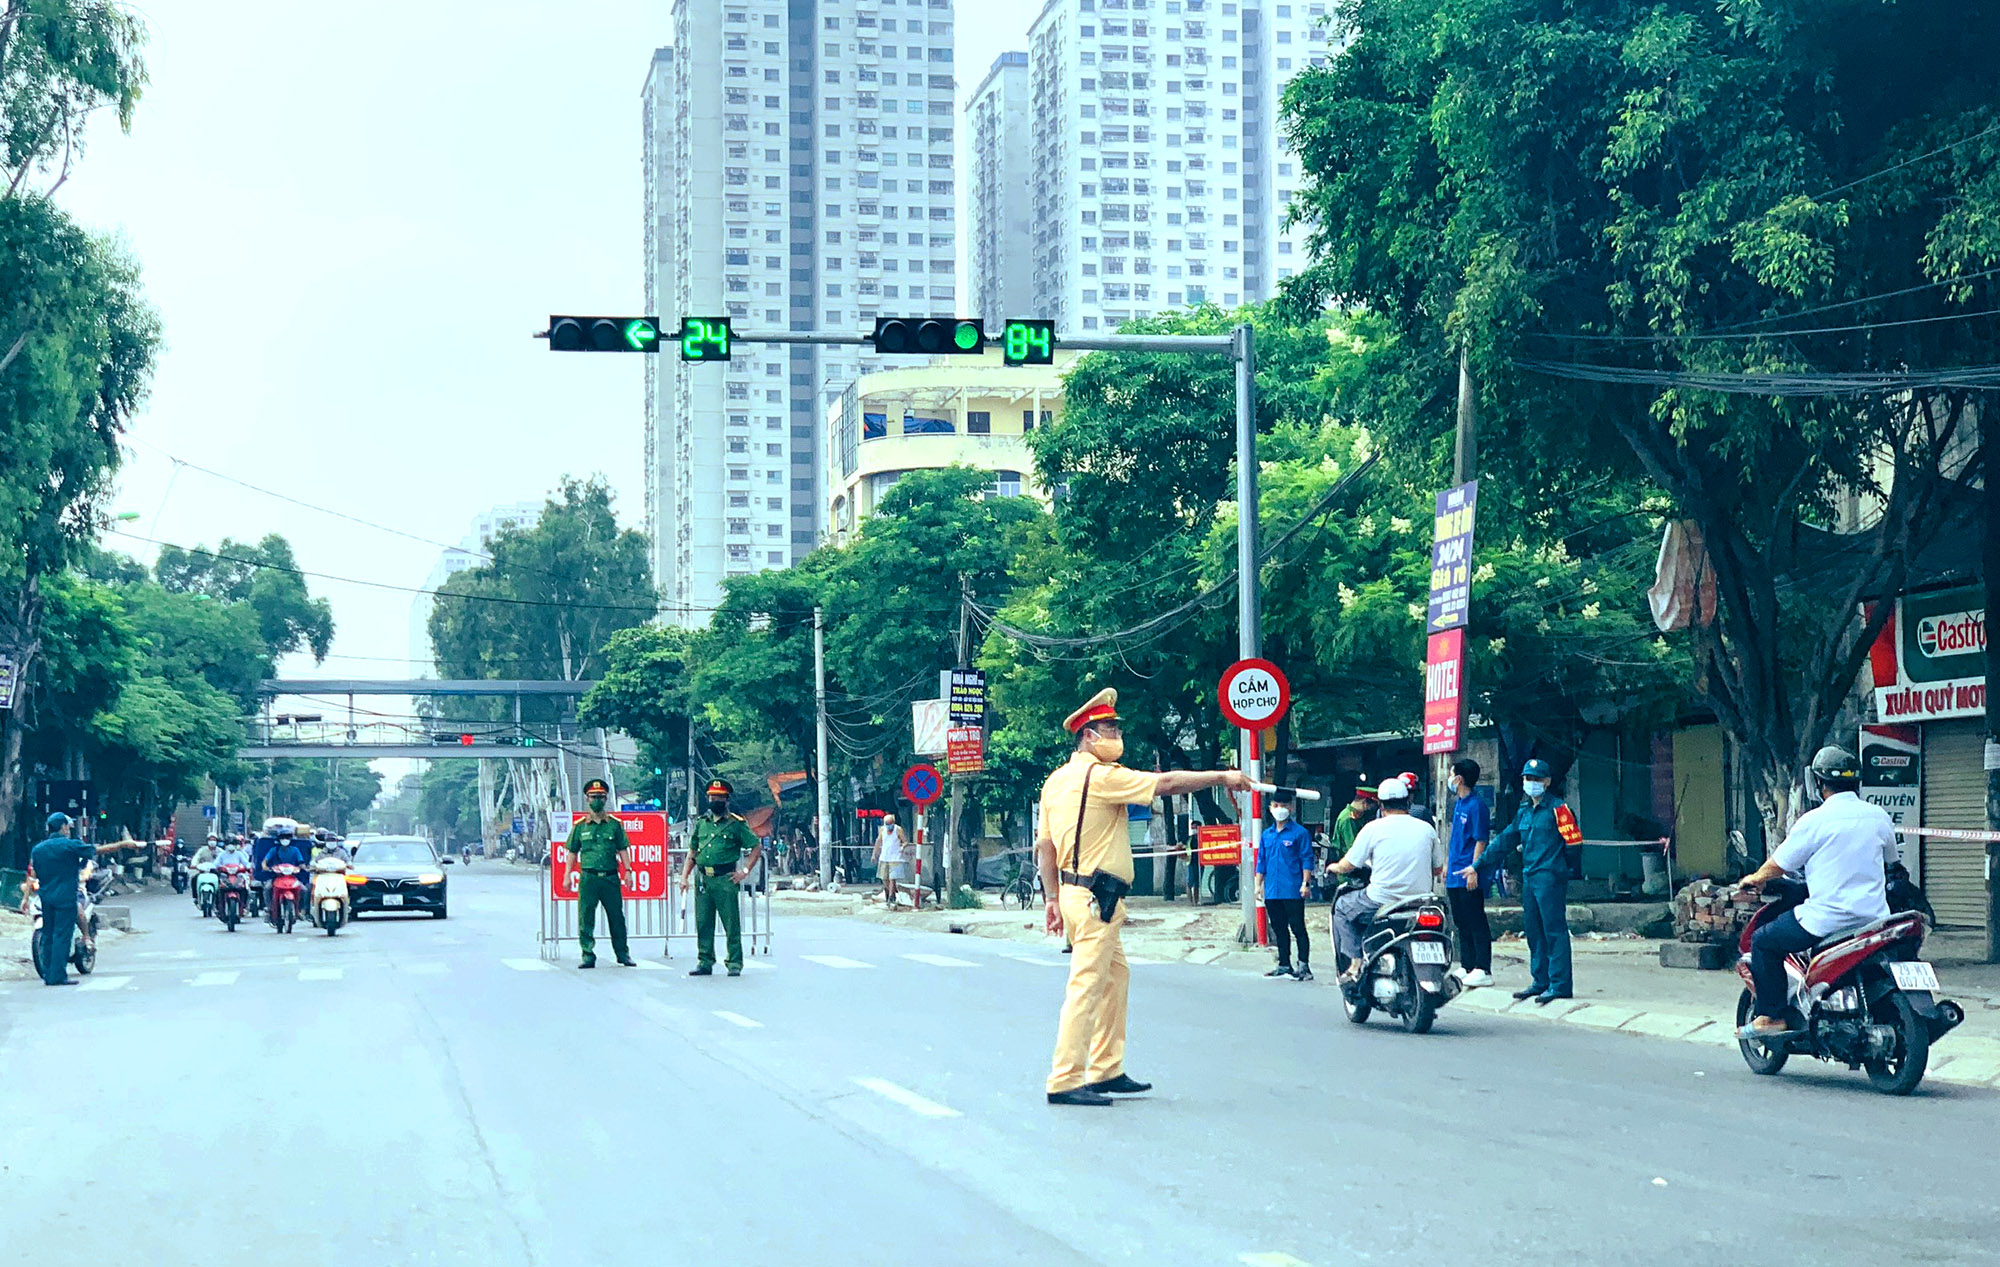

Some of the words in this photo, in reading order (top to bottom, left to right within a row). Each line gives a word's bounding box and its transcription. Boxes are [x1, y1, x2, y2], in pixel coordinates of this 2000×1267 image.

[683, 320, 727, 357] 24
[1007, 323, 1049, 360] 84
[1238, 675, 1269, 694] CẤM
[1426, 659, 1458, 702] HOTEL
[1233, 698, 1255, 710] HỌP
[1256, 695, 1277, 708] CHỢ
[1885, 687, 1922, 716] XUÂN
[1925, 682, 1955, 715] QUÝ
[1866, 793, 1915, 806] CHUYÊN
[639, 845, 662, 866] DỊCH
